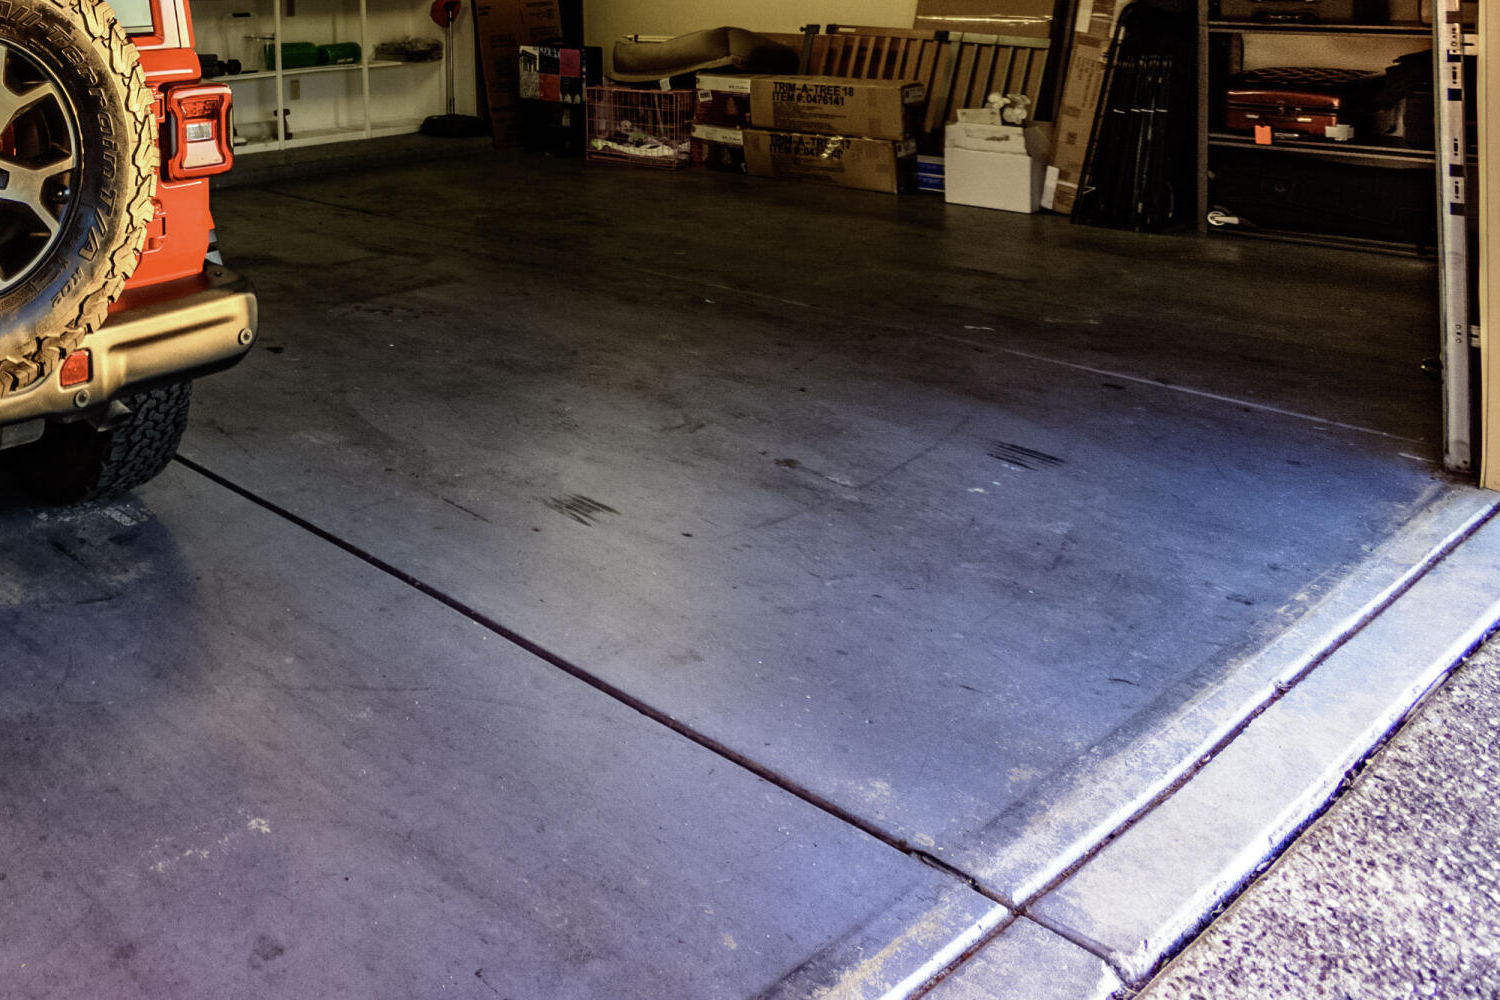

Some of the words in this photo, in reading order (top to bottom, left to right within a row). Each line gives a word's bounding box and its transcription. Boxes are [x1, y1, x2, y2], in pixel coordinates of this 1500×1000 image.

[773, 81, 841, 97] TRIM-A-TREE
[844, 86, 854, 97] 18
[772, 91, 795, 103] ITEM
